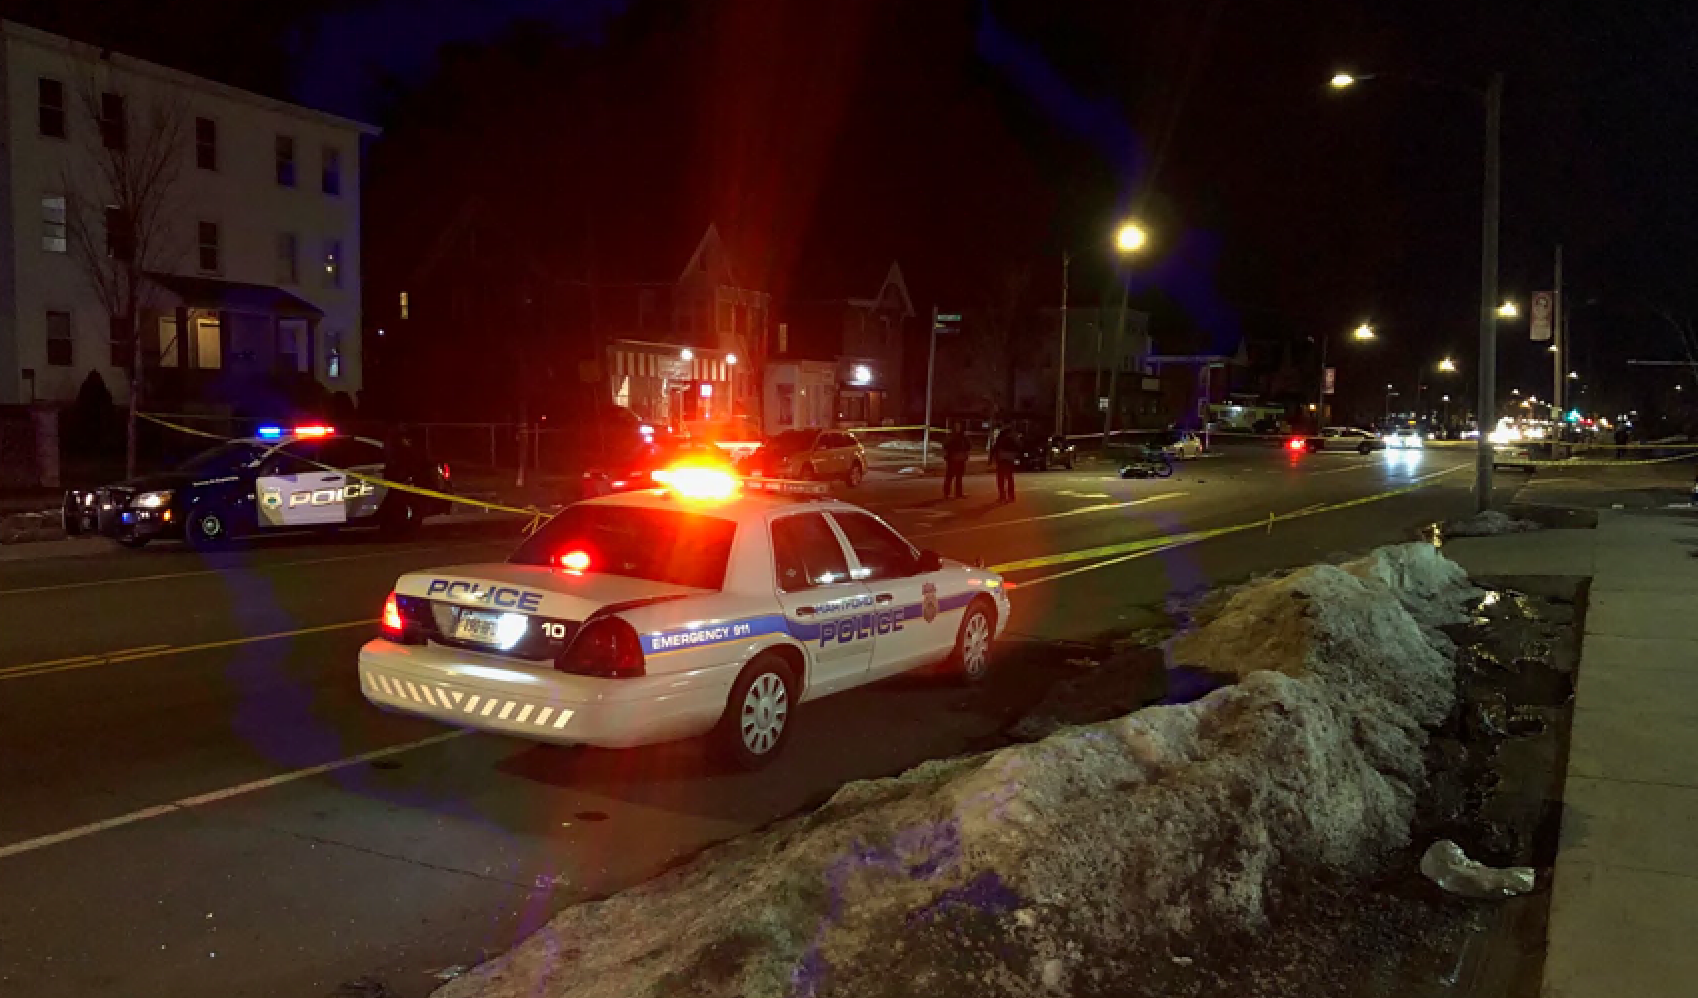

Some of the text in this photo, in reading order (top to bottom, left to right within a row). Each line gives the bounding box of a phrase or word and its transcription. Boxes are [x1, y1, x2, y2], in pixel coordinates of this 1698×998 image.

[541, 622, 566, 638] 10
[651, 623, 751, 649] EMERGENCY 911
[820, 608, 905, 648] POLICE
